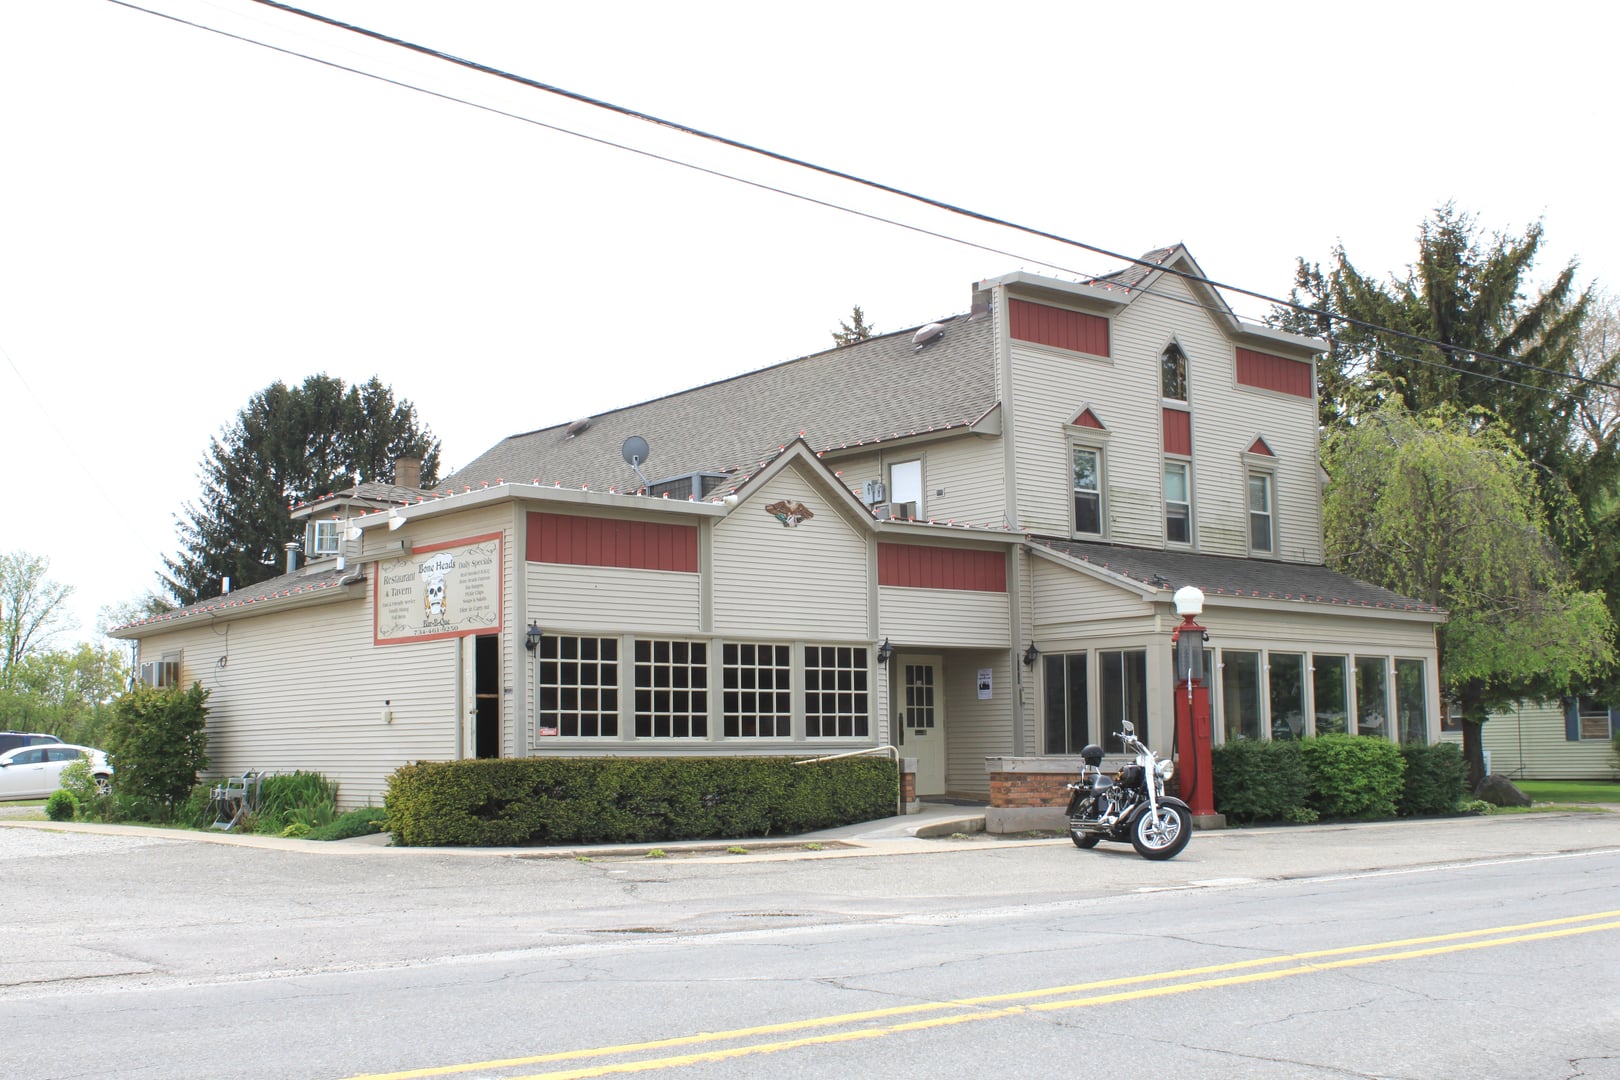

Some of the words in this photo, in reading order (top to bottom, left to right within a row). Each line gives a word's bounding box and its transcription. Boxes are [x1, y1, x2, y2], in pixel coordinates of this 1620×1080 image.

[418, 563, 434, 574] Bone
[436, 559, 456, 570] Heads
[471, 557, 493, 568] Specials
[383, 572, 416, 585] Restaurant
[391, 587, 412, 597] Tavern
